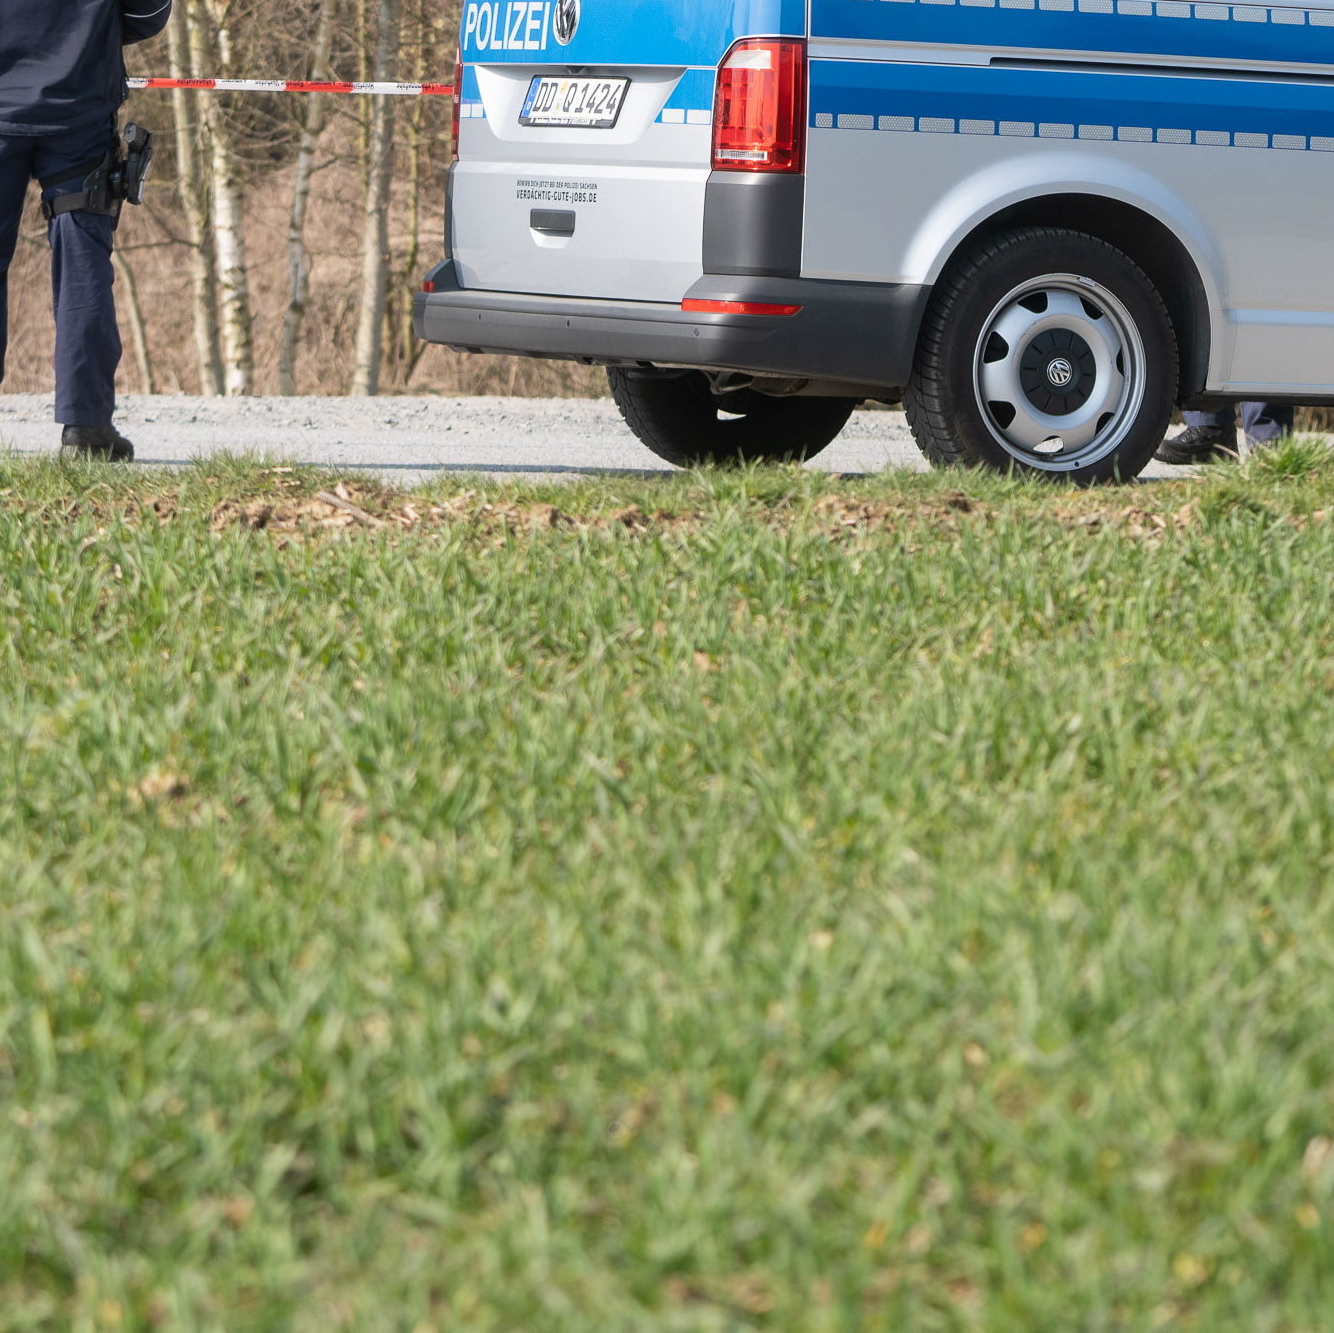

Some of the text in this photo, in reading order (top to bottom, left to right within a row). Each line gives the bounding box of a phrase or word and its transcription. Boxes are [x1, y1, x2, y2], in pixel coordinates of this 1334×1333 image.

[463, 1, 551, 51] POLIZEI
[532, 82, 559, 112] DD
[574, 82, 621, 115] 1424
[516, 188, 597, 204] VERDÄCHTIG-GUTE-JOBS.DE
[579, 182, 598, 190] SACHSEN
